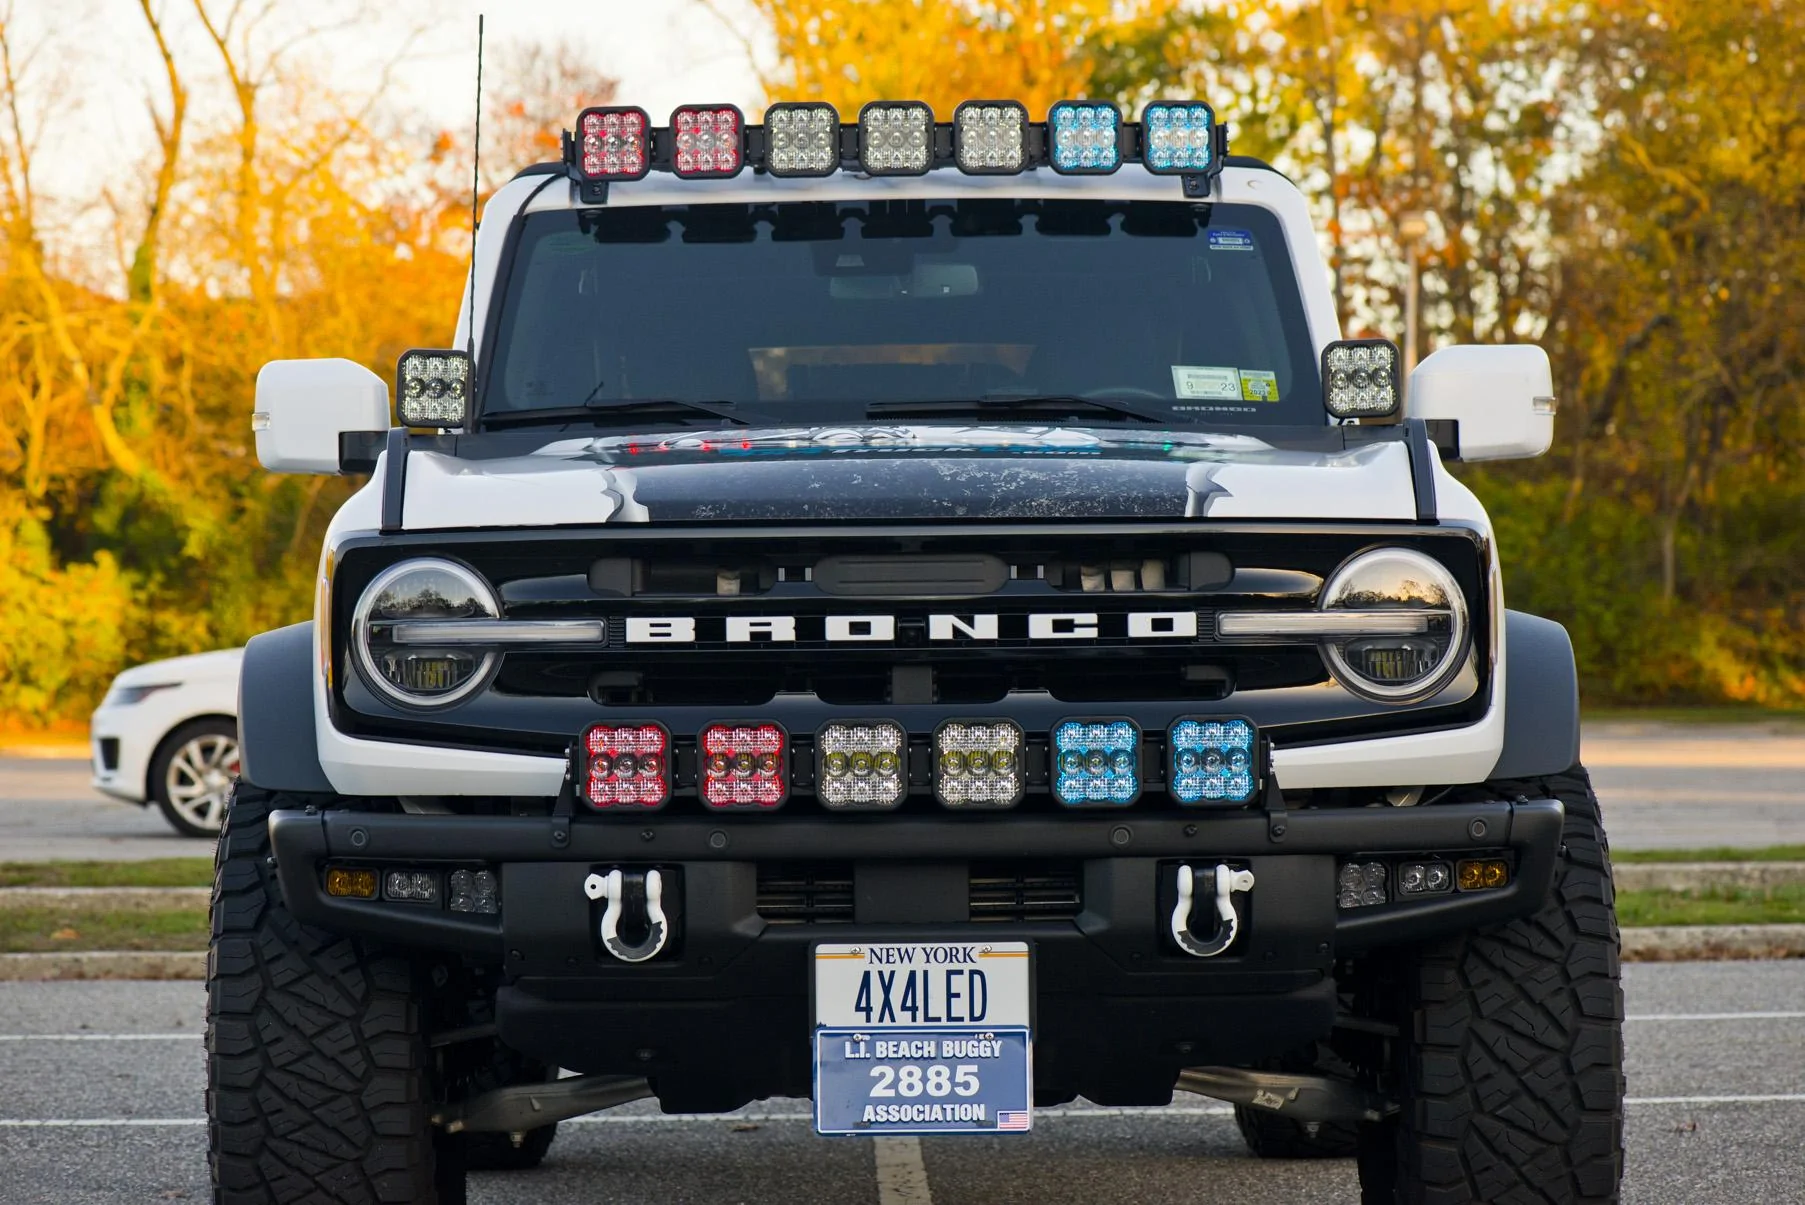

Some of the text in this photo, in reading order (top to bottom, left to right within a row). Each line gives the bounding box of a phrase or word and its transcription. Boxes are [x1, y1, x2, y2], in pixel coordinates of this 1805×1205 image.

[1220, 382, 1236, 392] 23
[625, 613, 1198, 643] BRONCO
[868, 947, 977, 964] NEW YORK
[855, 969, 987, 1023] 4X4LED
[845, 1040, 1002, 1059] L.I. BEACH BUGGY
[869, 1064, 980, 1097] 2885
[863, 1104, 985, 1122] ASSOCIATION
